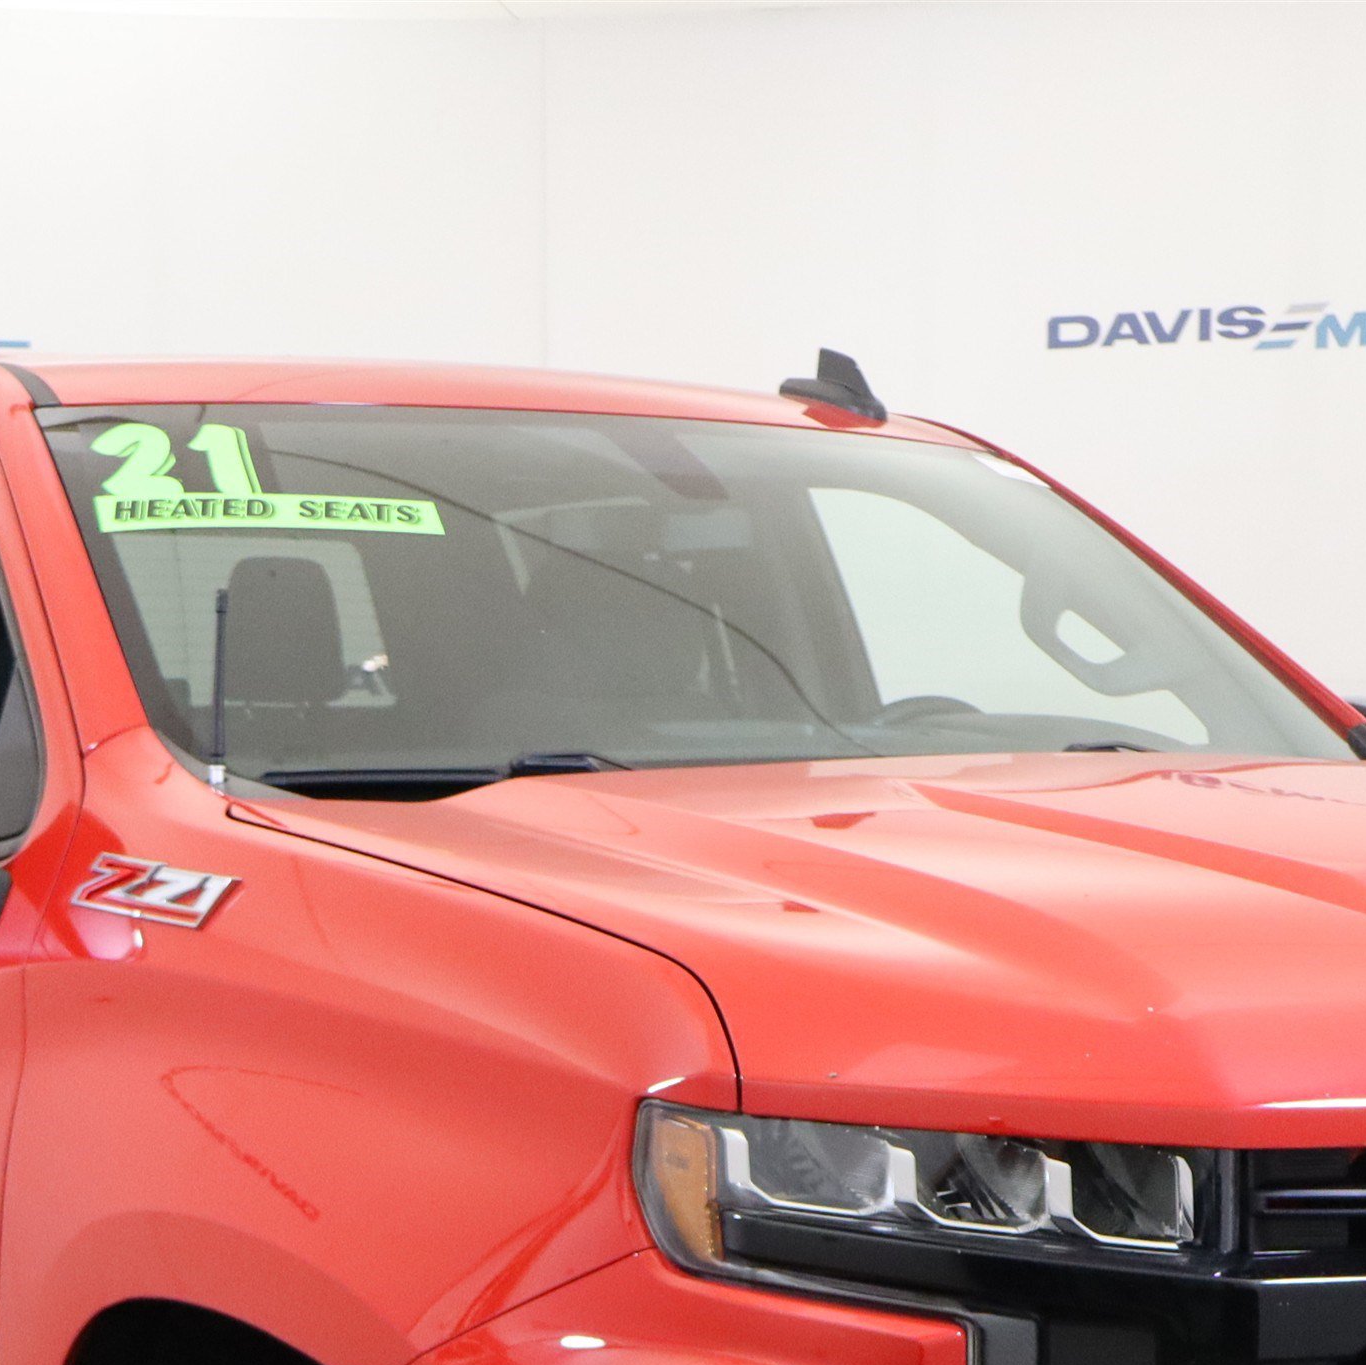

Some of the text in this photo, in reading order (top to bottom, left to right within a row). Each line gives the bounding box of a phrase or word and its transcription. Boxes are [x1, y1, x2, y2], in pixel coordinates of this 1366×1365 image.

[1046, 305, 1267, 350] DAVIS
[89, 422, 265, 496] 21
[113, 497, 422, 525] HEATED SEATS
